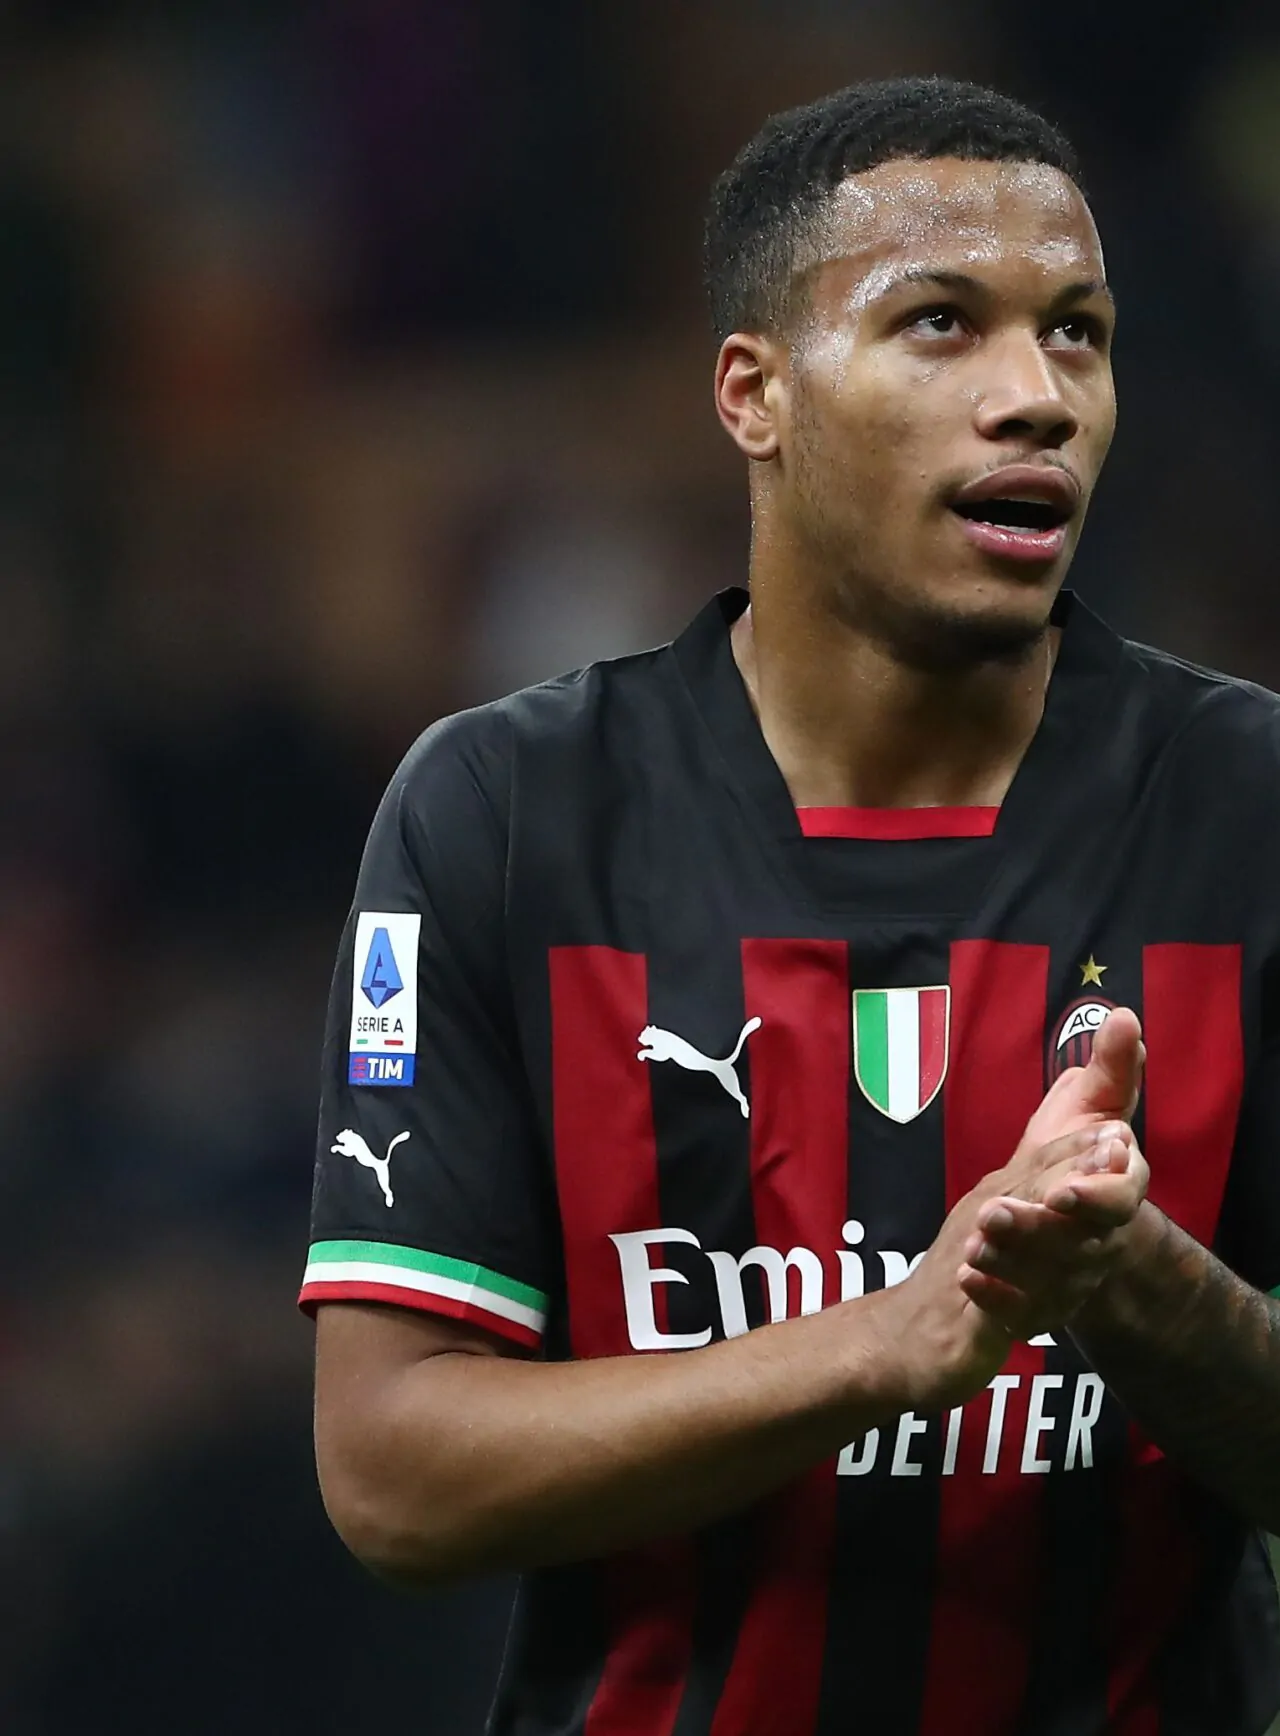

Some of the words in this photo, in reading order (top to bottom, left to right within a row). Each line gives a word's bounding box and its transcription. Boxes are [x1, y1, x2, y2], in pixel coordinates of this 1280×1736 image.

[357, 1016, 389, 1033] SERIE
[393, 1018, 404, 1033] A
[1068, 1008, 1108, 1034] AC
[367, 1057, 404, 1080] TIM
